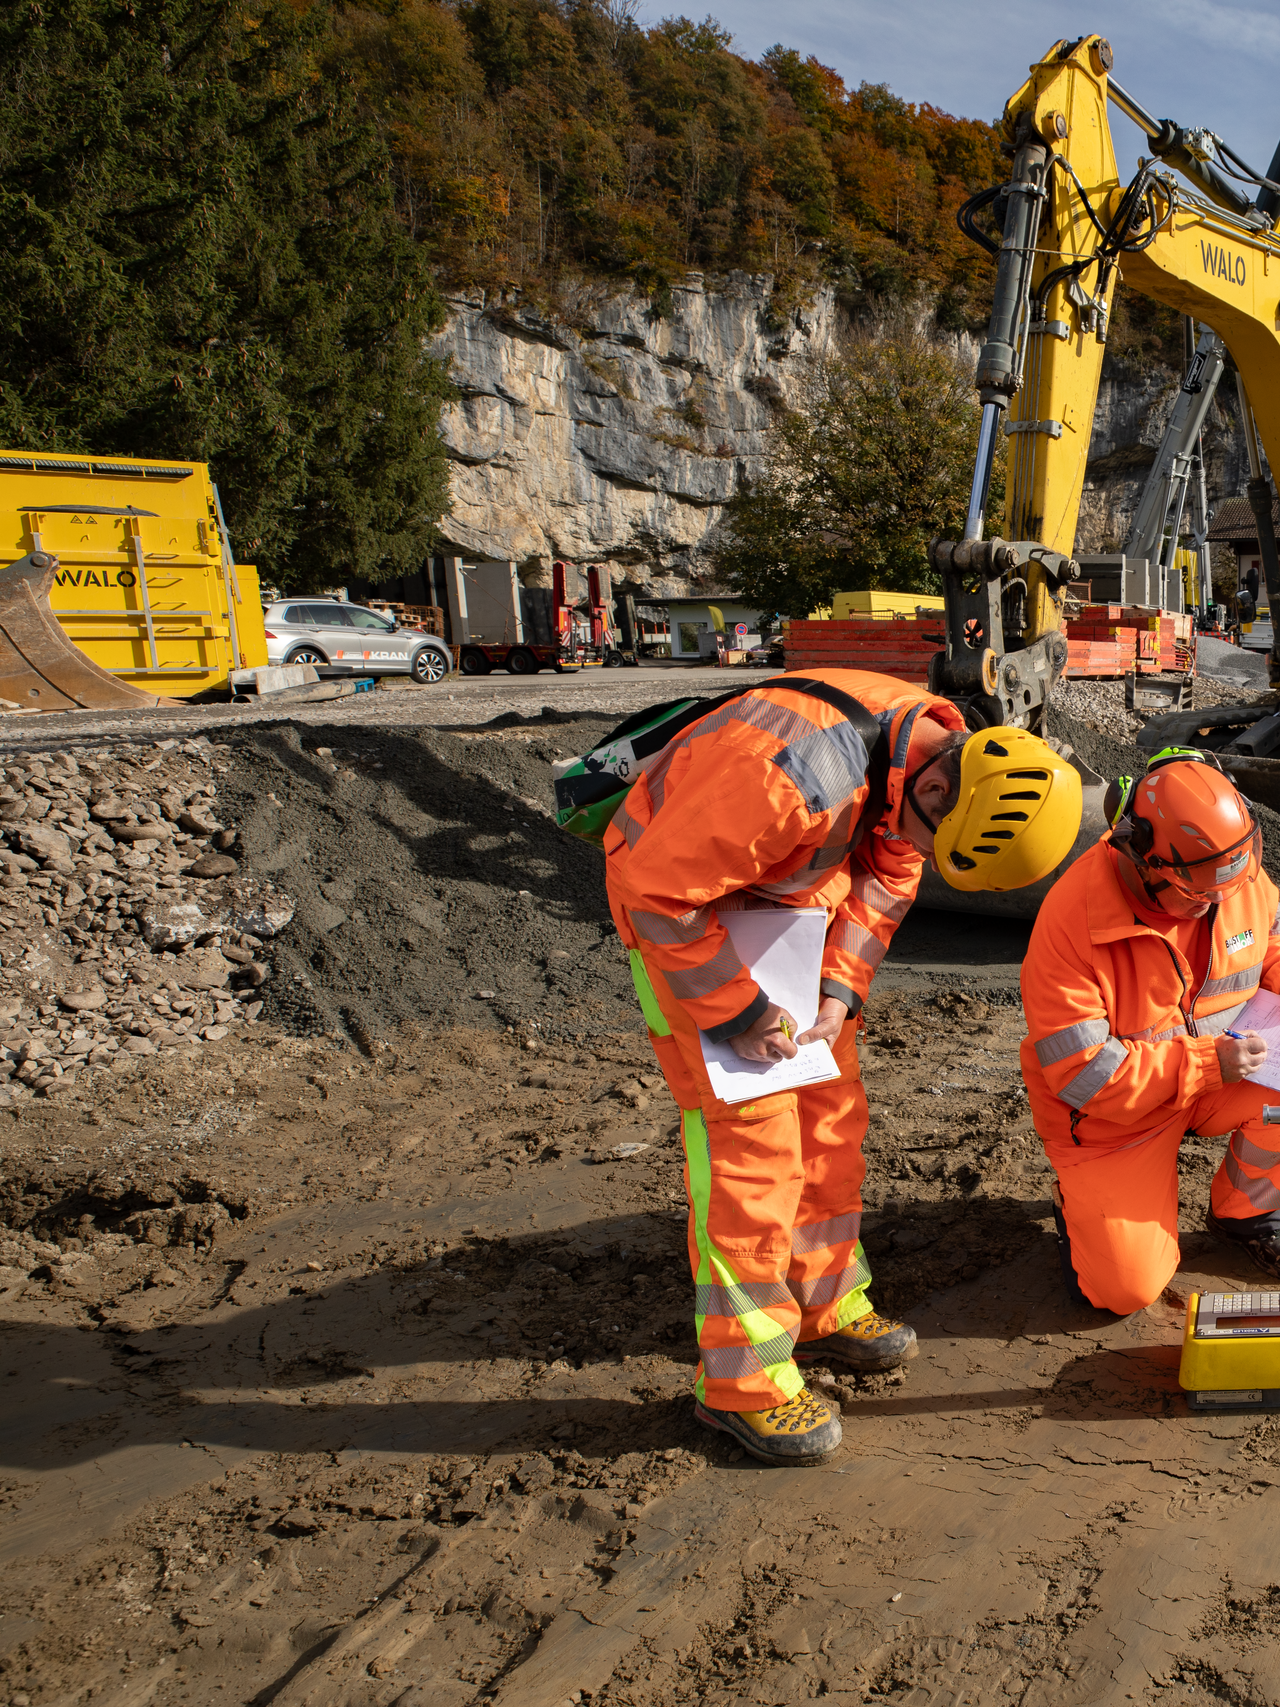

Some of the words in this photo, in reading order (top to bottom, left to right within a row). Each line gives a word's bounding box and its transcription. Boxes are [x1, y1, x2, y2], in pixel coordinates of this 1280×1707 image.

[1200, 239, 1246, 287] WALO
[54, 570, 137, 588] WALO
[371, 651, 408, 660] KRAN
